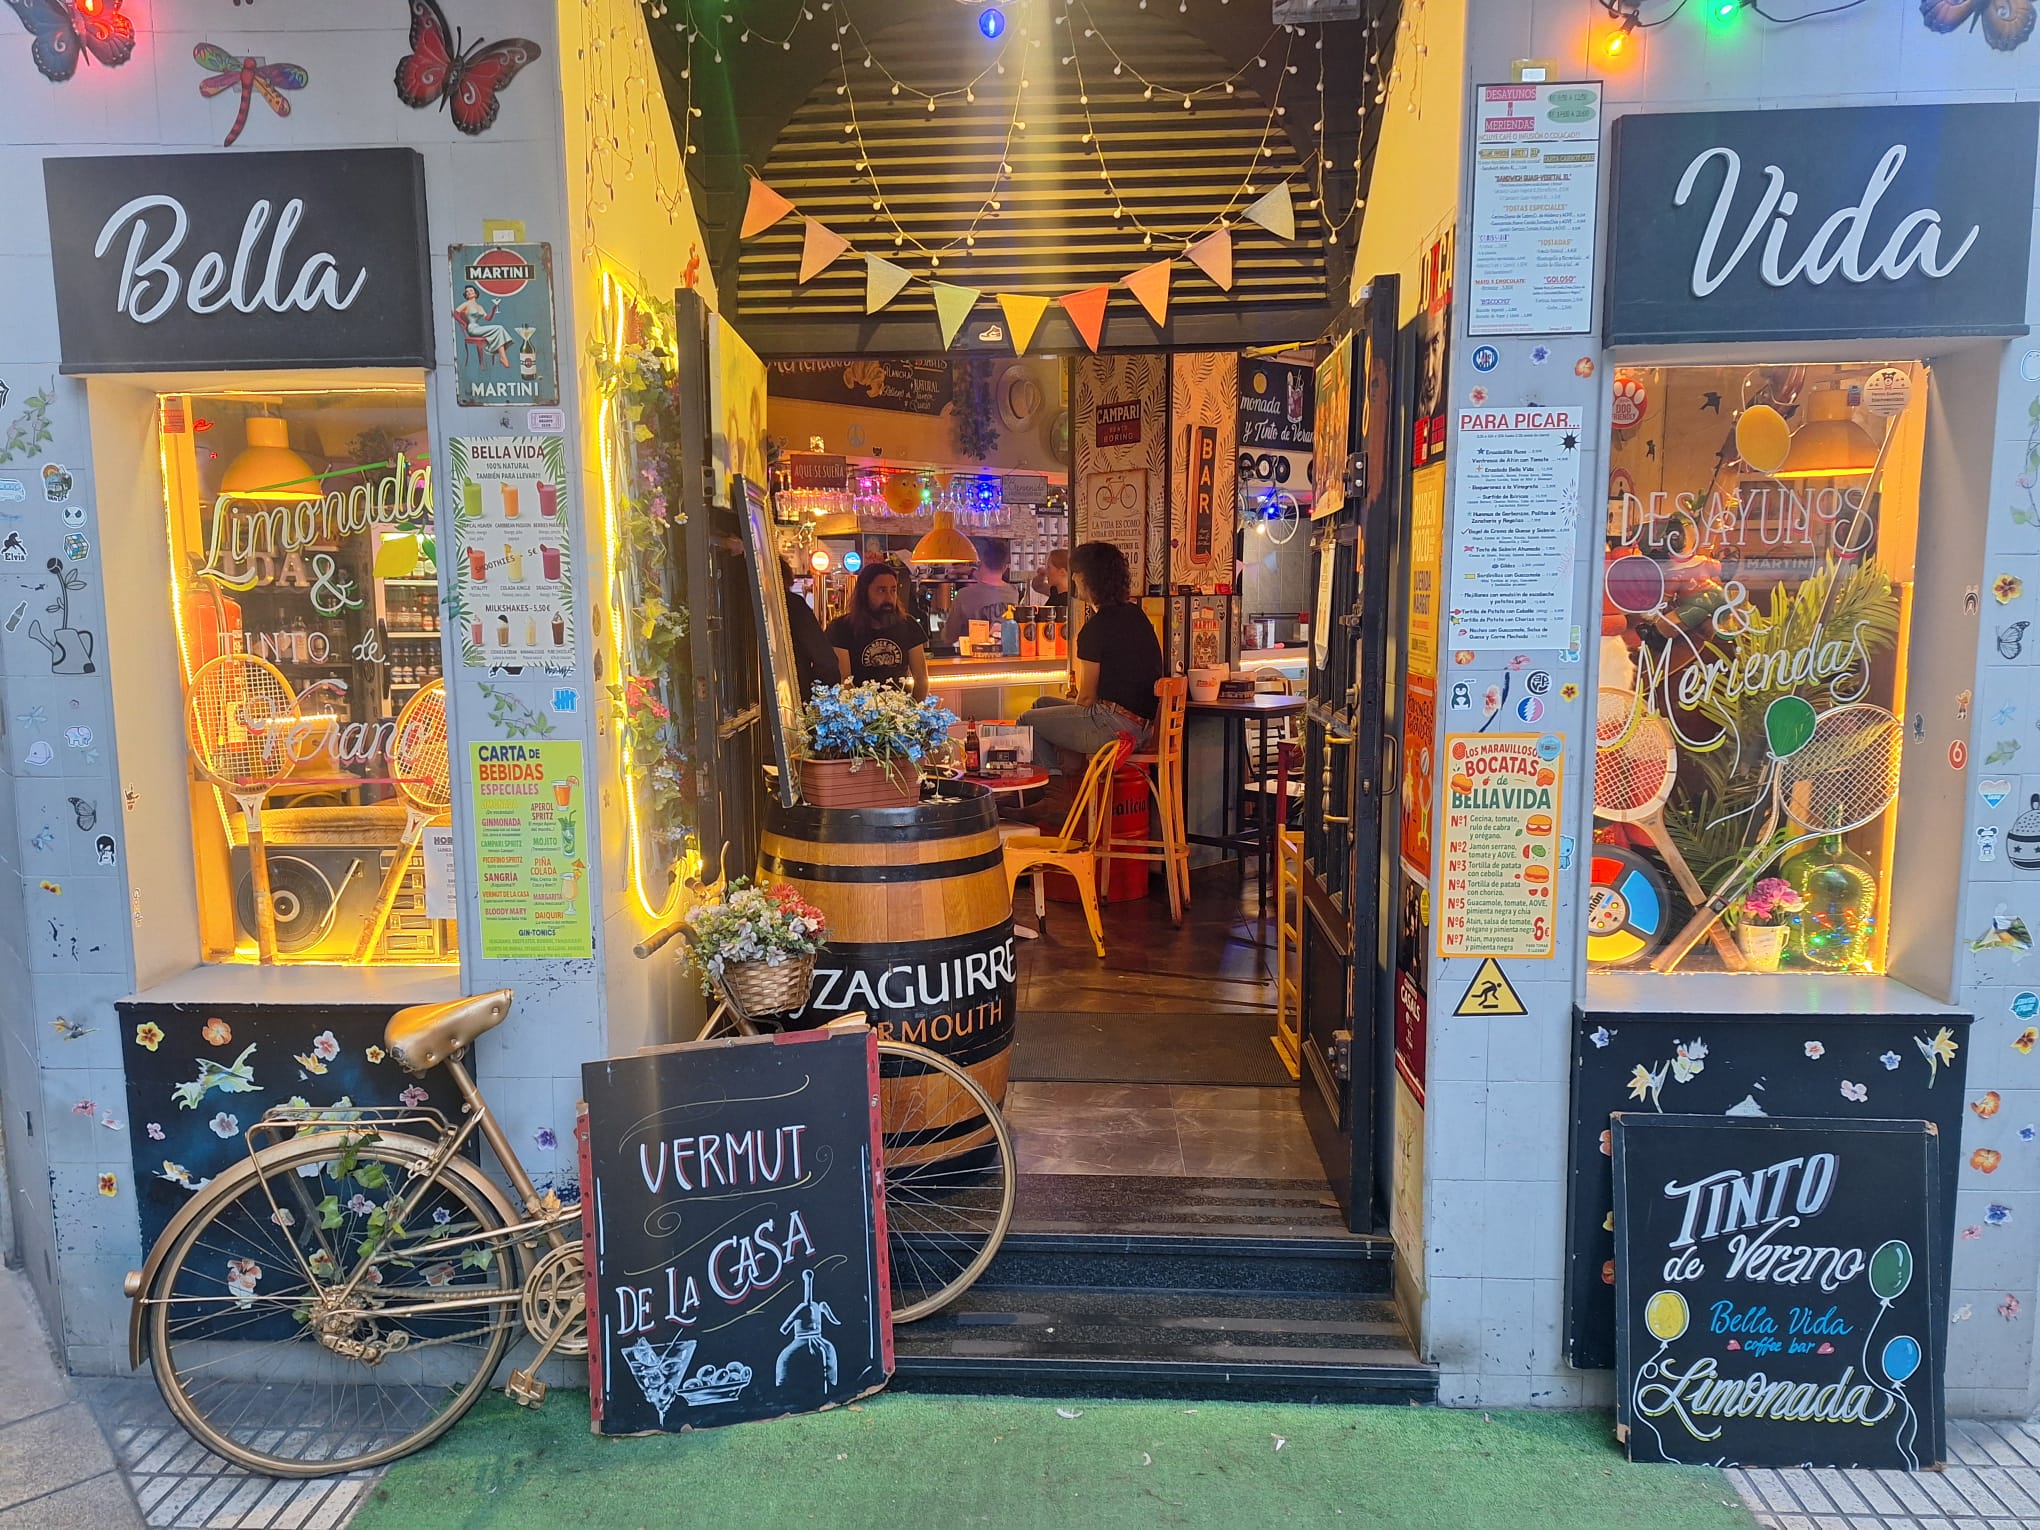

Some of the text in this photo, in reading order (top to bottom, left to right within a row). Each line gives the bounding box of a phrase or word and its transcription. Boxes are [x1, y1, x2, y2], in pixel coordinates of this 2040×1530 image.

[1674, 144, 1980, 299] Vida
[95, 194, 367, 325] Bella
[470, 267, 528, 280] MARTINI
[471, 382, 539, 397] MARTINI
[1240, 391, 1281, 415] imonada
[1615, 403, 1632, 414] DOG
[1096, 403, 1140, 424] CAMPARI
[1460, 412, 1580, 430] PARA PICAR...
[1254, 418, 1278, 442] Tinto
[1280, 426, 1290, 441] de
[1103, 432, 1133, 443] BORING
[471, 445, 546, 460] BELLA VIDA
[1200, 438, 1214, 514] BAR
[197, 452, 434, 589] Limonada
[1115, 519, 1123, 528] ES
[1123, 519, 1141, 529] COMO
[1620, 487, 1875, 559] DESAYUNOS
[4, 552, 25, 561] Elvis
[475, 554, 516, 574] SMOOTHIES
[1746, 558, 1817, 571] MARTINI
[310, 553, 364, 618] &
[485, 604, 529, 612] MILKSHAKES
[1712, 580, 1774, 638] &
[218, 628, 387, 664] TINTO de
[1597, 620, 1870, 749] Meriendas
[238, 678, 431, 766] Verano
[478, 745, 540, 762] CARTA DE
[1465, 746, 1479, 759] LOS
[1480, 743, 1542, 760] MARAVILLOSO
[479, 763, 545, 781] BEBIDAS
[1465, 756, 1540, 778] BOCATAS
[1496, 775, 1509, 786] de
[480, 783, 540, 796] ESPECIALES
[530, 802, 554, 811] APEROL
[1111, 799, 1147, 816] alicia
[481, 818, 522, 827] GINMONADA
[531, 812, 554, 821] SPRITZ
[1470, 814, 1494, 823] Cecina,
[1495, 815, 1520, 823] tomate,
[1469, 823, 1511, 831] rulo de cabra
[532, 837, 558, 846] MOJITO
[1469, 833, 1474, 841] y
[1469, 842, 1490, 850] Jamón
[1491, 843, 1517, 851] serrano,
[534, 856, 552, 867] PIÑA
[1468, 861, 1491, 869] Tortilla
[1491, 861, 1500, 869] de
[1501, 861, 1522, 870] patata
[483, 872, 518, 882] SANGRÍA
[530, 867, 558, 876] COLADA
[1467, 880, 1491, 888] Tortilla
[1500, 881, 1521, 889] patata
[1466, 899, 1502, 907] Guacamole,
[1503, 899, 1529, 907] tomate,
[484, 908, 509, 916] BLOODY
[534, 912, 564, 920] DAIQUIRI
[1466, 907, 1494, 916] pimienta
[1494, 908, 1513, 916] negra
[1513, 908, 1517, 916] y
[1466, 917, 1483, 926] Atún,
[1483, 917, 1502, 925] salsa
[1503, 917, 1512, 925] de
[1511, 917, 1533, 926] tomate,
[518, 929, 556, 937] GIN-TONICS
[1465, 926, 1489, 934] orégano
[1489, 926, 1493, 934] y
[1483, 936, 1514, 944] mayonesa
[1497, 944, 1514, 952] negra
[789, 937, 1017, 1020] ZAGUIRRE
[877, 998, 1004, 1044] RMOUTH
[639, 1124, 808, 1195] VERMUT
[1664, 1153, 1839, 1249] TINTO
[1663, 1215, 1866, 1294] de Verano
[616, 1286, 655, 1337] DE
[707, 1209, 818, 1304] CASA
[1710, 1299, 1854, 1337] Bella Vida
[1743, 1338, 1816, 1358] coffee bar
[1637, 1357, 1897, 1441] Limonada
